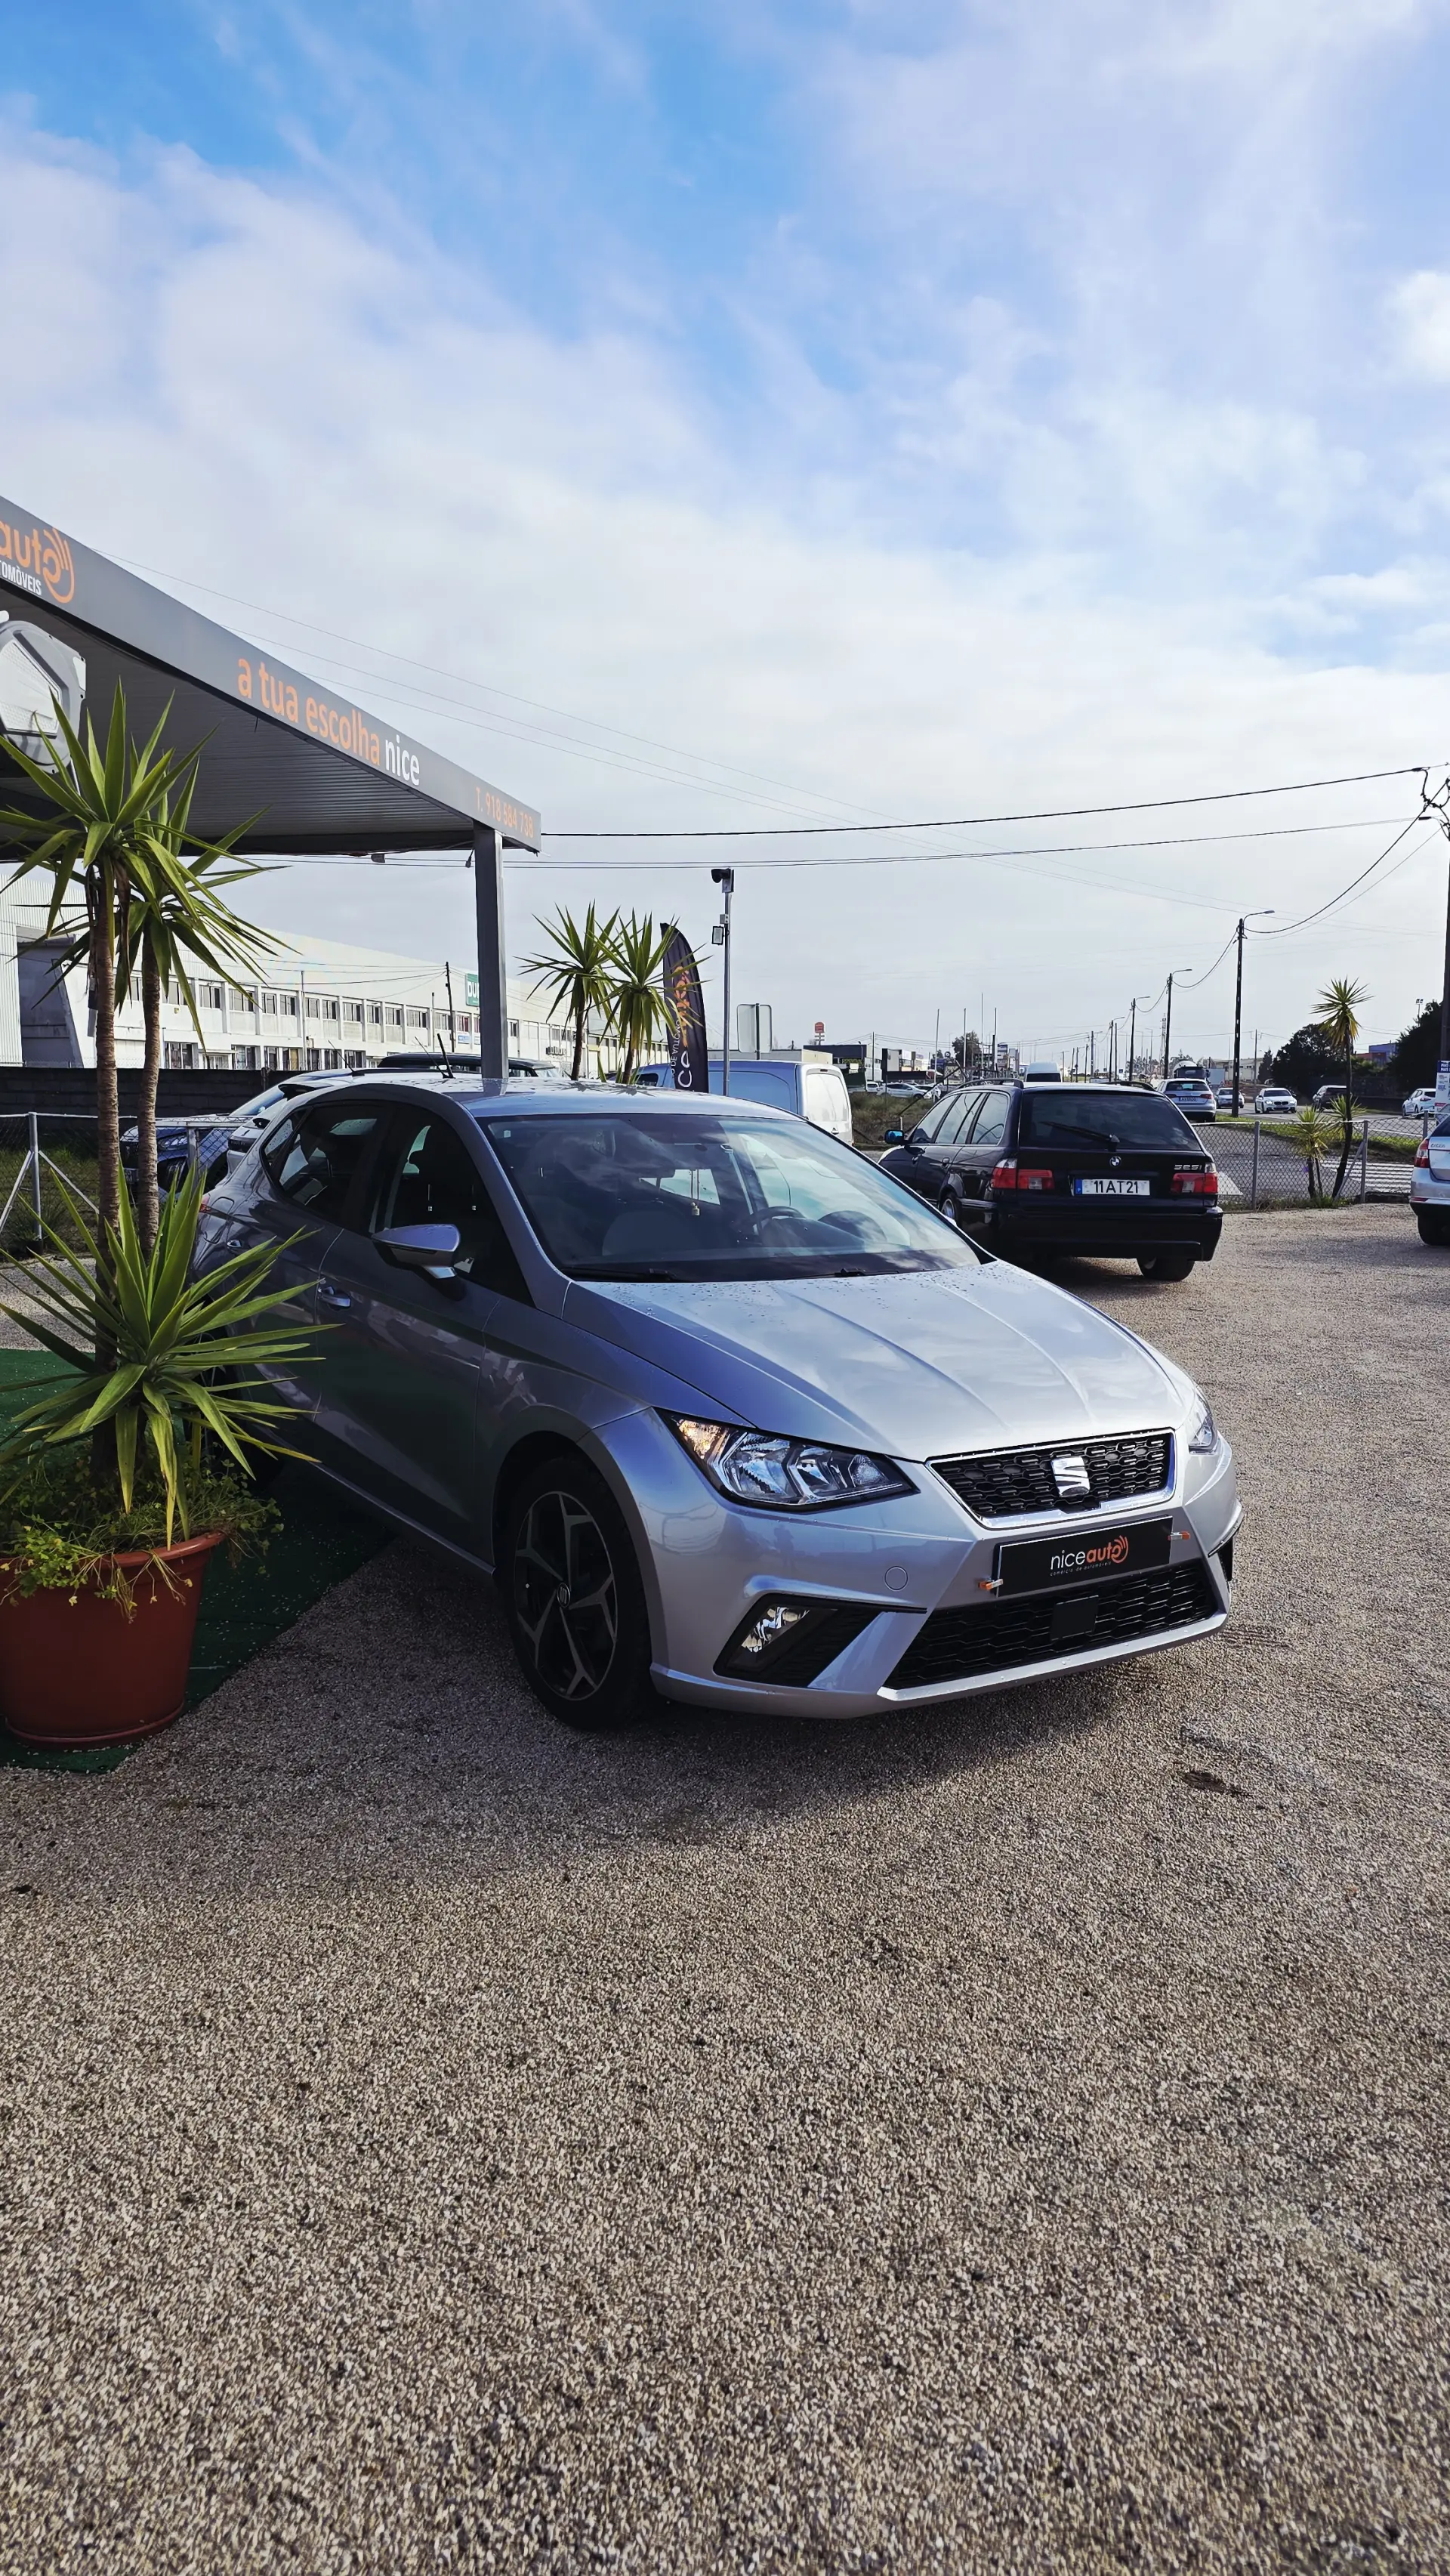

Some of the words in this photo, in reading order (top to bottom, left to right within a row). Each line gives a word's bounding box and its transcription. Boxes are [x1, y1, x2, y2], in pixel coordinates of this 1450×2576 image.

[237, 659, 252, 699] a
[258, 662, 299, 723] tua
[305, 696, 381, 765] escolha
[385, 734, 420, 786] nice
[476, 786, 483, 812] T.
[486, 792, 501, 822] 918
[503, 802, 517, 829] 584
